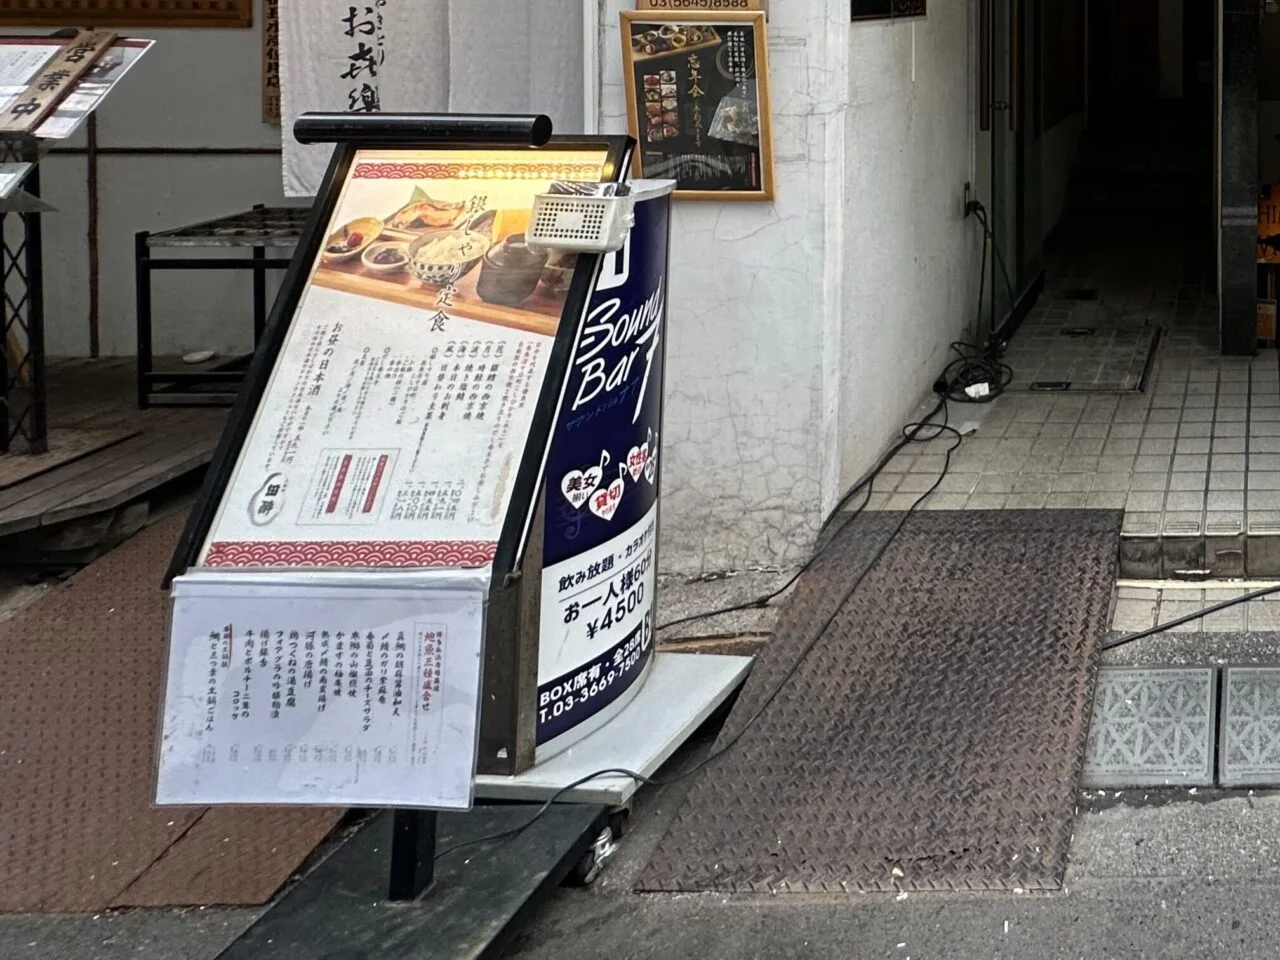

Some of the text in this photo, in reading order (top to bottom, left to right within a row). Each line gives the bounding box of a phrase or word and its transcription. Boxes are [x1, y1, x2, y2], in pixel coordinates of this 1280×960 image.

[10, 42, 97, 122] 営業中
[576, 275, 664, 365] Sound
[307, 321, 343, 396] お昼の日本酒
[571, 346, 639, 411] Bar
[566, 473, 598, 493] 美女
[595, 484, 621, 512] 貸切
[586, 581, 645, 640] ¥4500
